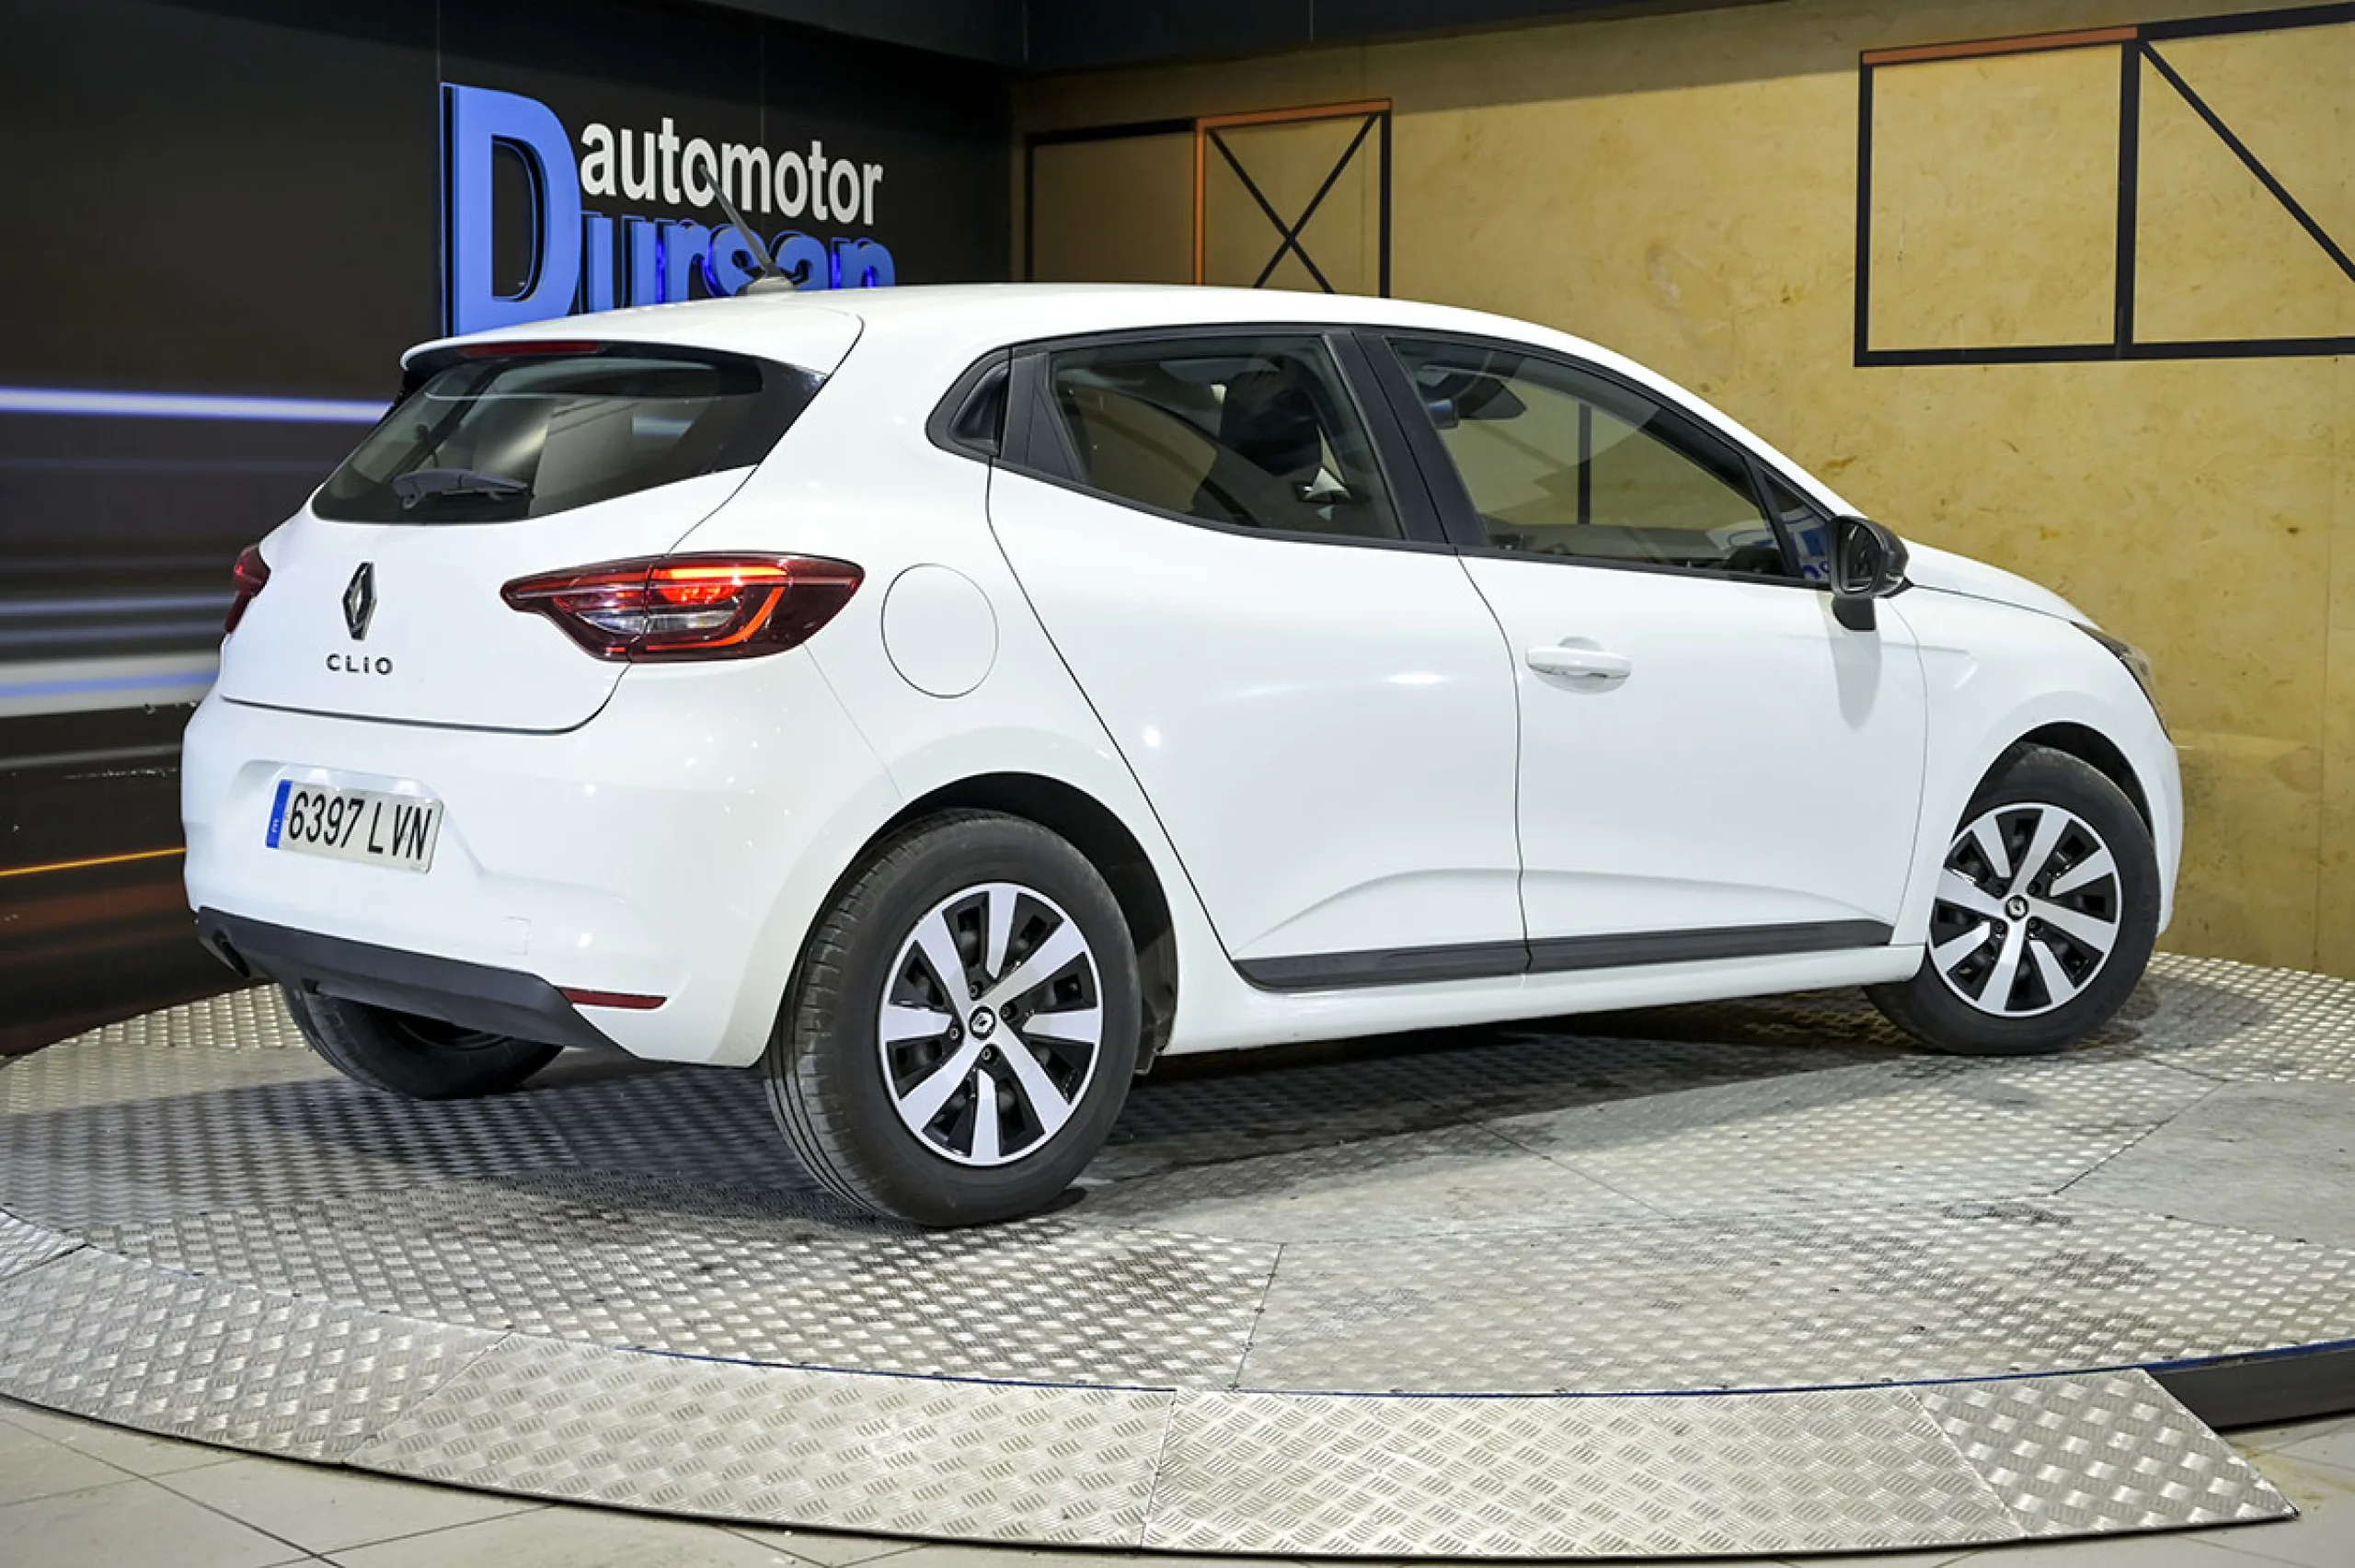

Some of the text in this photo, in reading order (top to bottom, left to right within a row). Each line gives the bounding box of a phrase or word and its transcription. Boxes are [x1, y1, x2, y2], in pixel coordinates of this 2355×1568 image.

[580, 117, 883, 225] automotor
[288, 791, 431, 860] 6397 LVN
